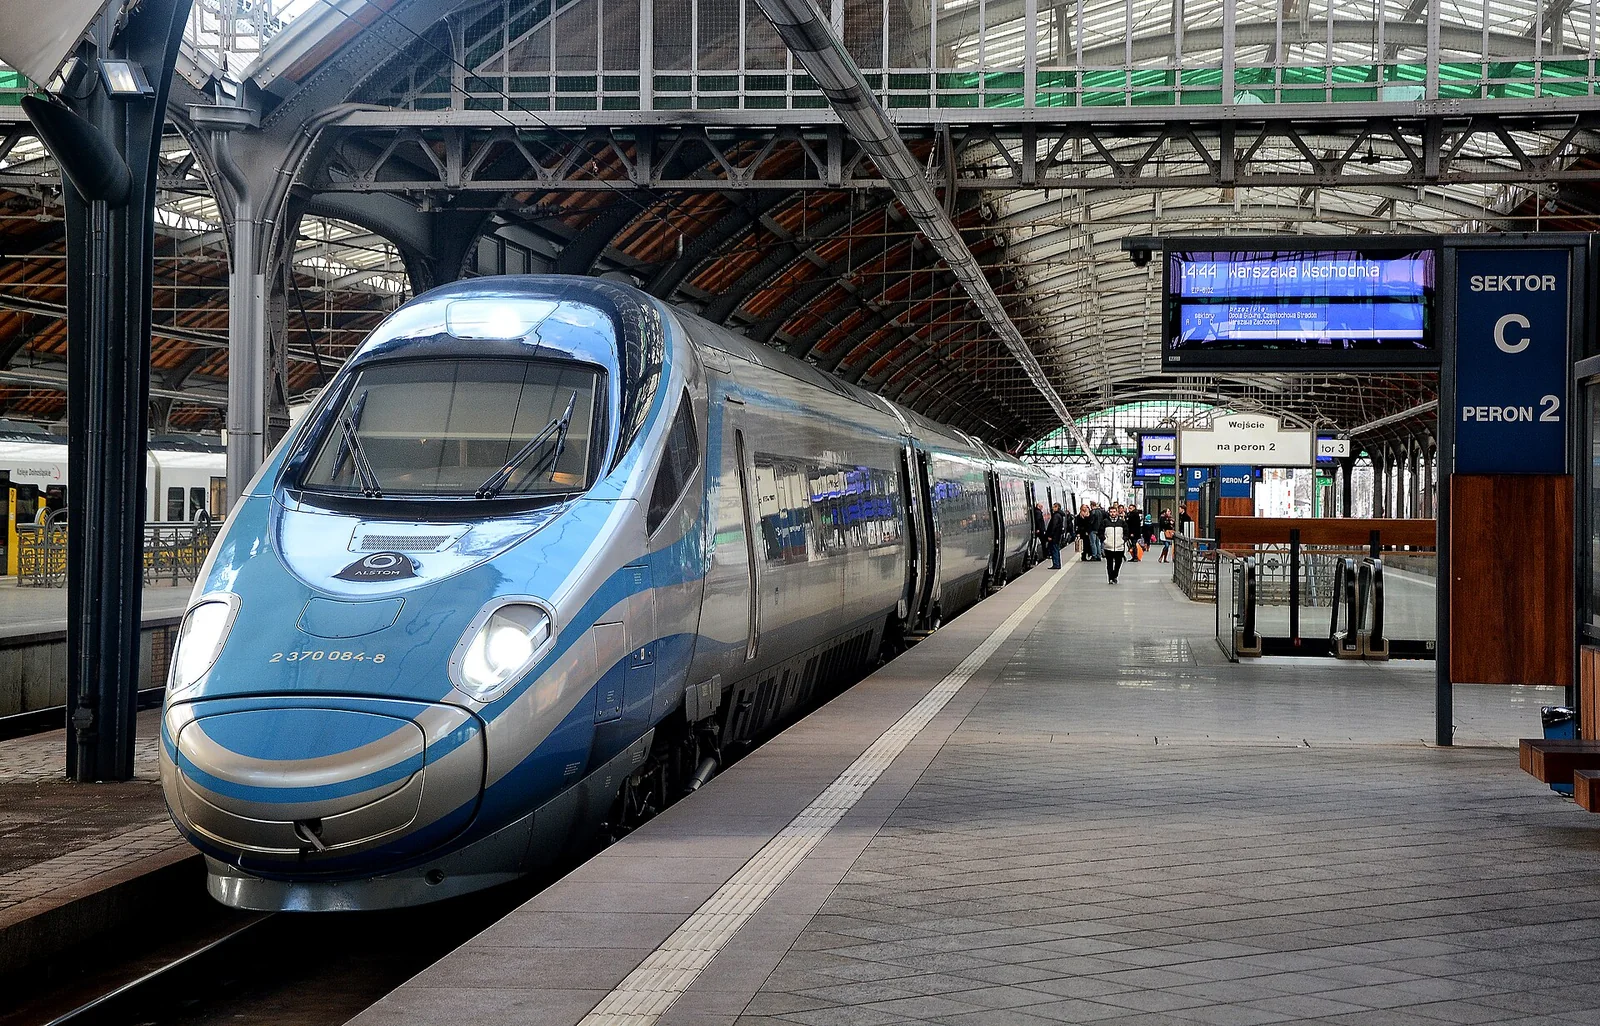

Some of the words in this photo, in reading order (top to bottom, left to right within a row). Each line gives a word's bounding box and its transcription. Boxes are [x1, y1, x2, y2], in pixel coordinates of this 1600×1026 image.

[1181, 262, 1218, 279] 14:44
[1229, 262, 1297, 279] Warszawa
[1302, 261, 1380, 278] Wschodnia
[1470, 275, 1556, 292] SEKTOR
[1494, 313, 1531, 354] C
[1462, 406, 1533, 422] PERON
[1539, 394, 1560, 422] 2
[1228, 421, 1265, 430] Wejście
[1148, 443, 1161, 452] tor
[1164, 442, 1171, 452] 4
[1234, 444, 1265, 453] peron
[1269, 442, 1276, 451] 2
[1321, 444, 1335, 453] tor
[1338, 443, 1345, 453] 3
[1194, 470, 1202, 479] B
[1243, 474, 1250, 484] 2
[269, 653, 283, 663] 2
[286, 651, 325, 661] 370
[328, 651, 386, 663] 084-8
